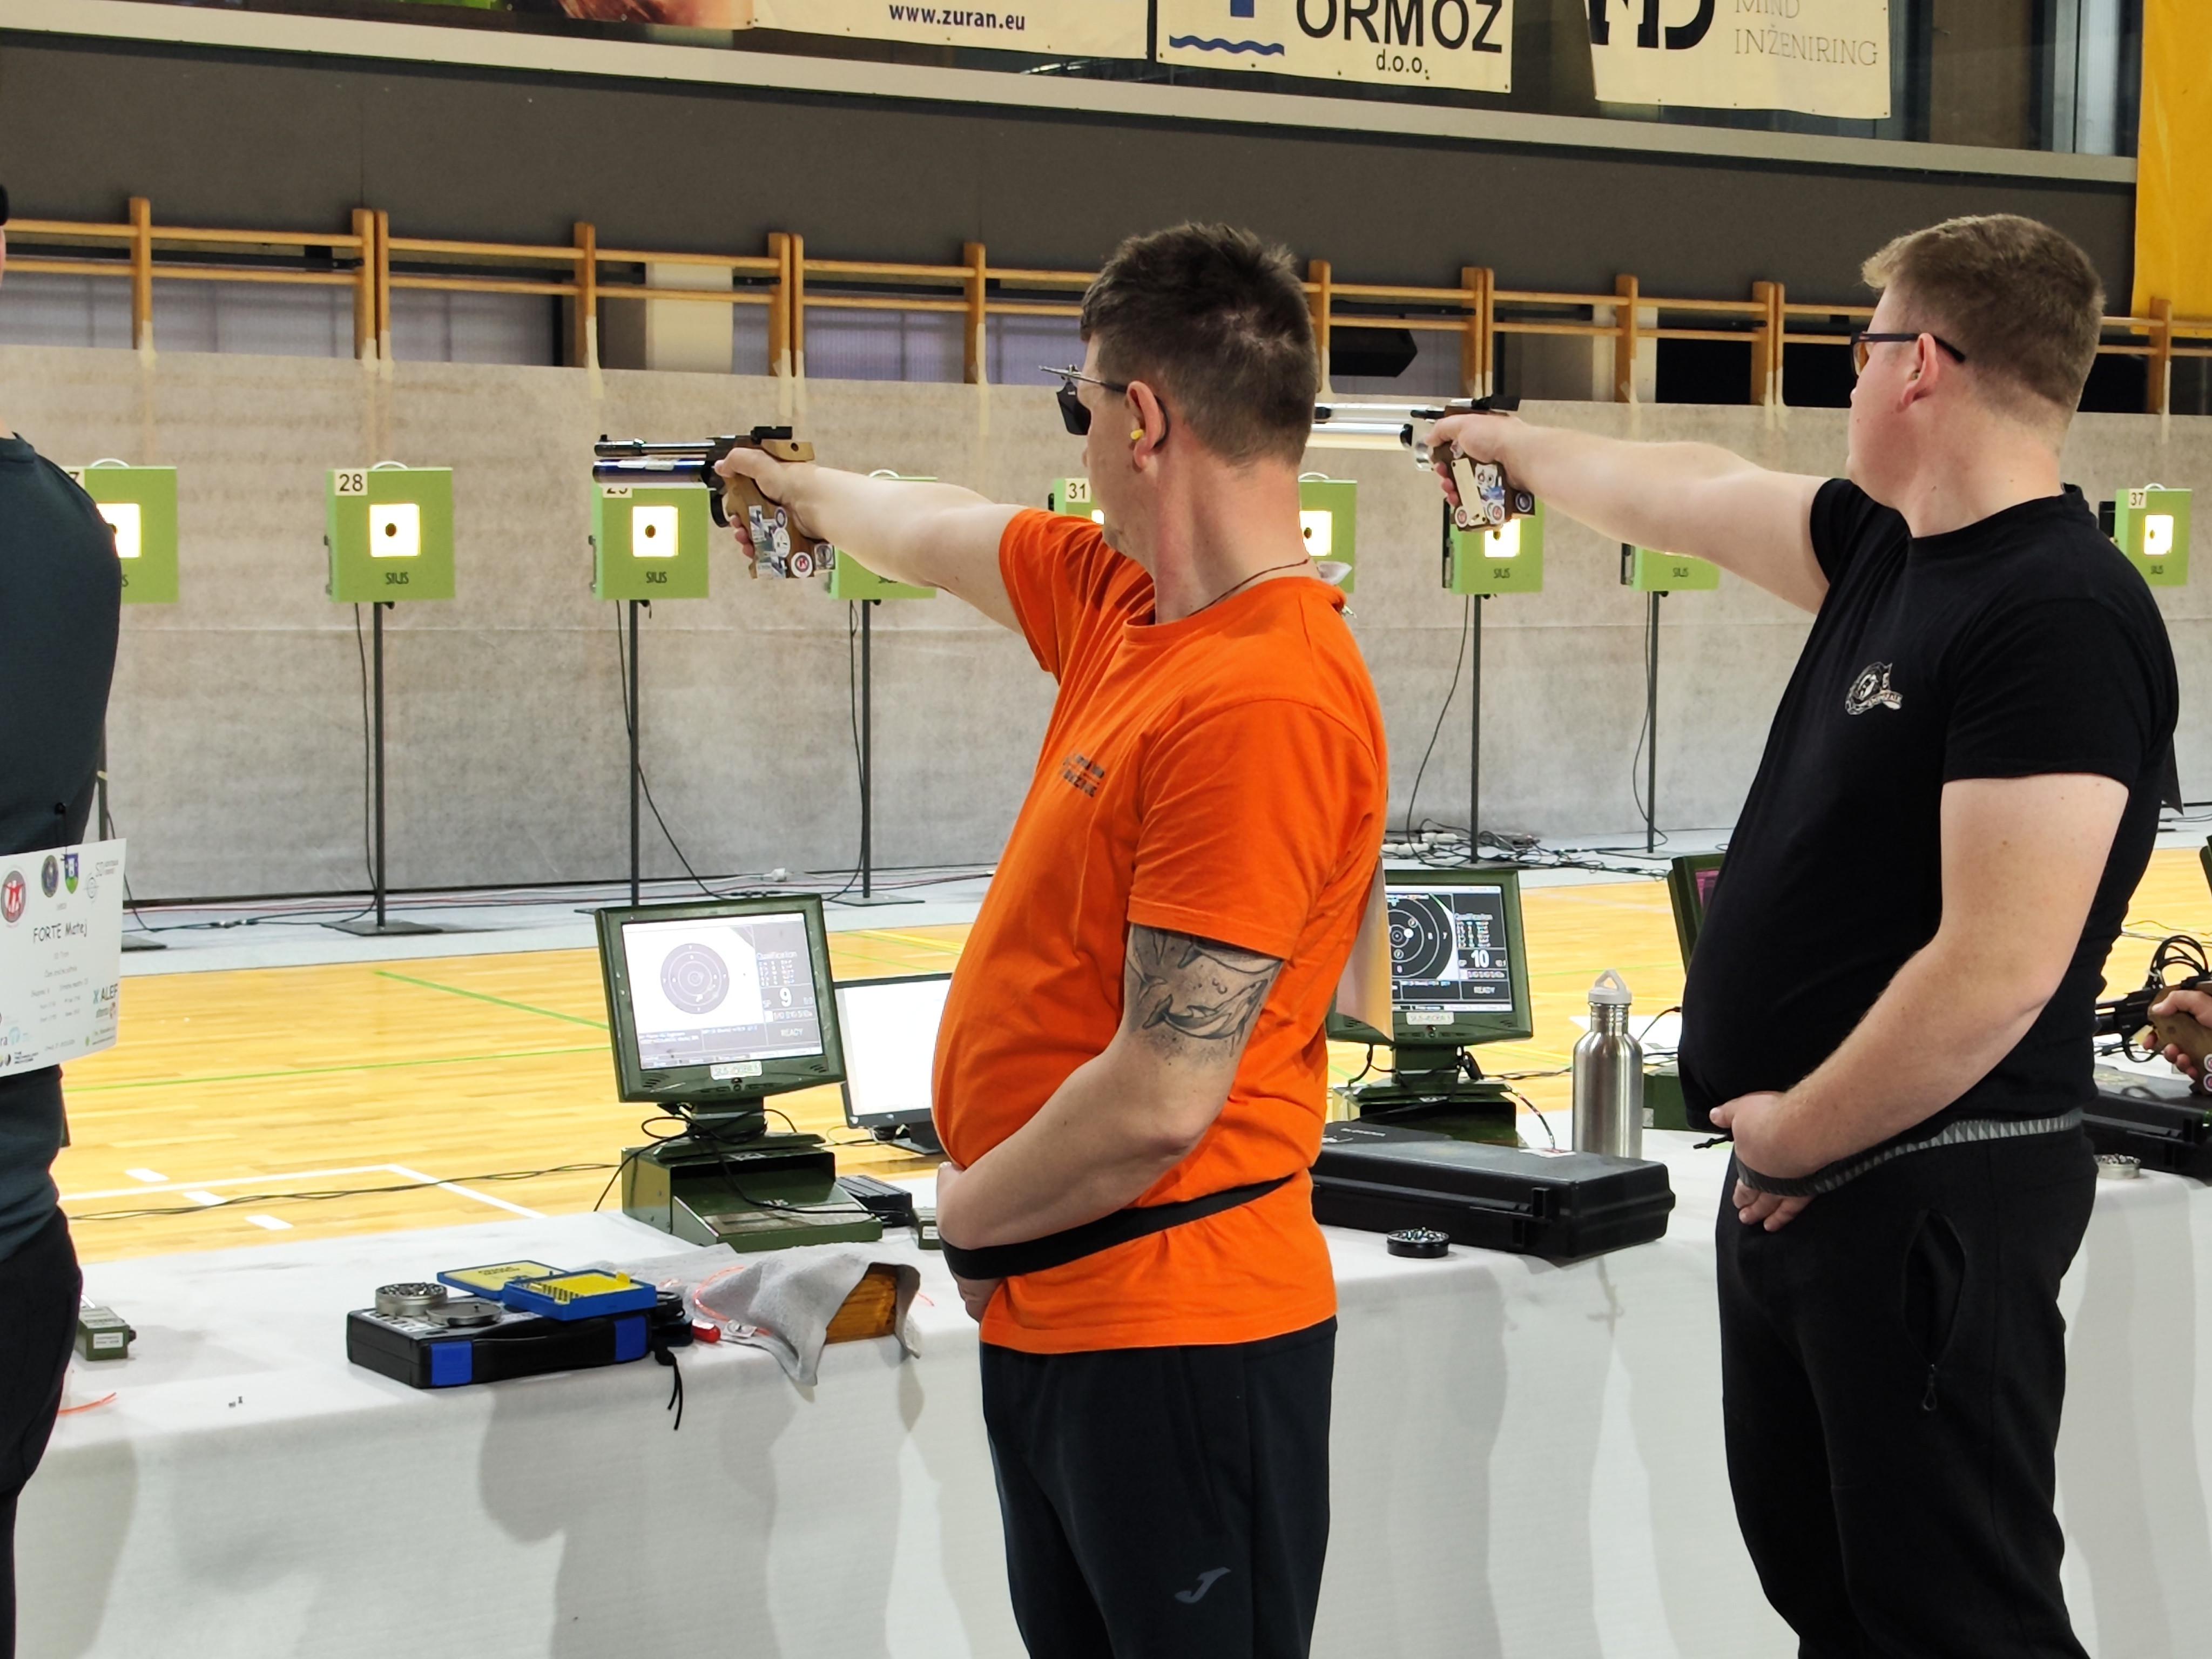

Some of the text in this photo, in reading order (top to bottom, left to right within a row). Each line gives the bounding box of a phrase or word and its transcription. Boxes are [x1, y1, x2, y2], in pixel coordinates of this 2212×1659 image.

[889, 4, 1025, 31] www.zuran.eu
[1735, 24, 1878, 66] INŽENIRING
[1375, 49, 1429, 73] d.o.o.
[339, 474, 363, 492] 28
[1069, 482, 1085, 500] 31
[2130, 492, 2144, 506] 37
[385, 571, 409, 585] SIUS
[646, 571, 667, 584] SIUS
[33, 922, 62, 943] FORTE
[1471, 949, 1489, 968] 10
[779, 987, 792, 1007] 9
